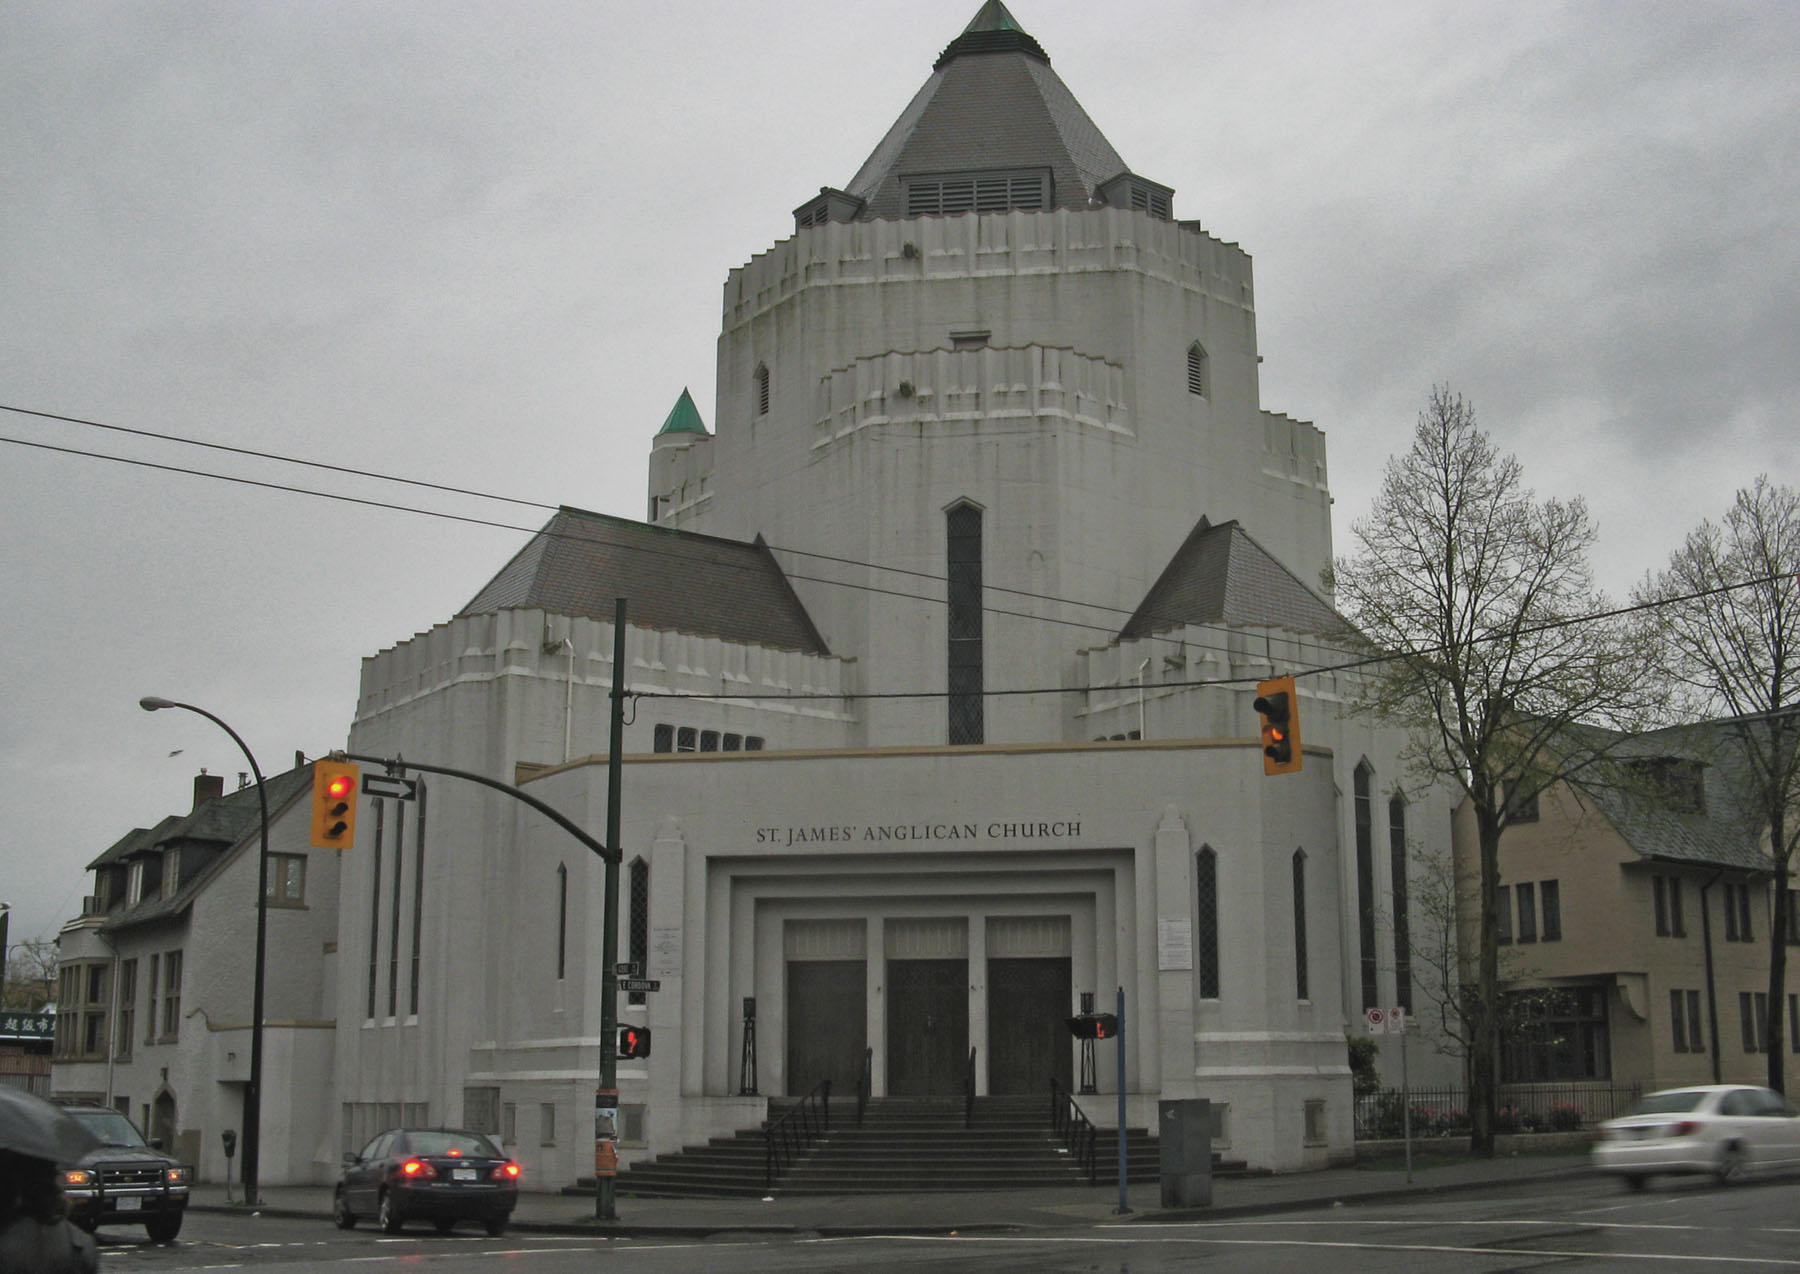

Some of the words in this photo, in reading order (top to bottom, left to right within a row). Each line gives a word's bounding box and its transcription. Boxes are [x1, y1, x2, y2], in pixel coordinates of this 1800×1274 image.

[756, 827, 781, 843] ST.
[786, 825, 857, 847] JAMES'
[863, 824, 977, 841] ANGLICAN
[987, 822, 1081, 839] CHURCH
[627, 981, 651, 991] CORDOVA
